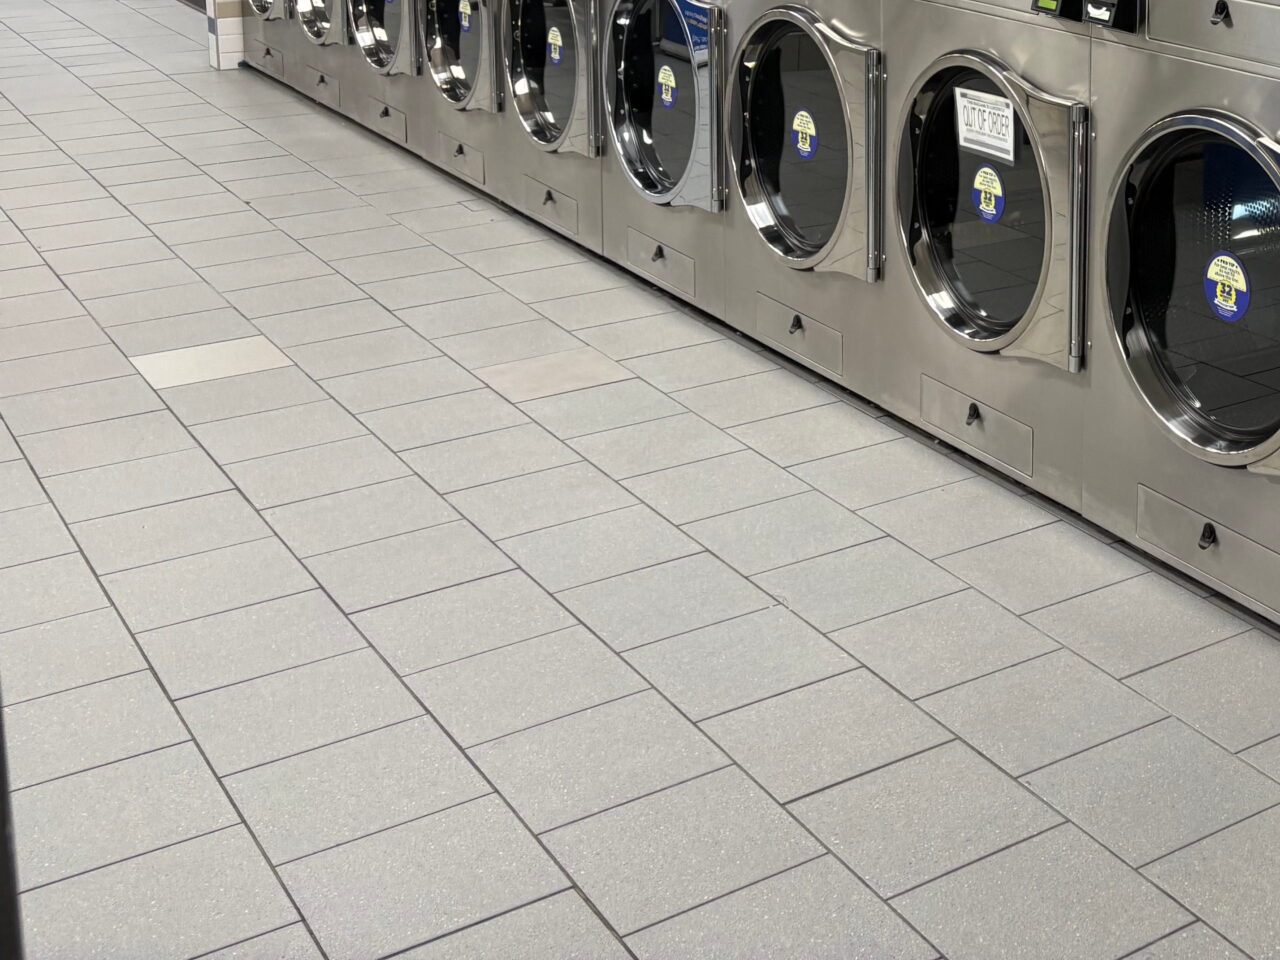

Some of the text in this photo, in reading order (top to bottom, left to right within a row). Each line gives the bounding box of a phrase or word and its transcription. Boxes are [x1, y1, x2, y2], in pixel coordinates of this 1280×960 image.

[963, 105, 976, 128] OUT
[978, 108, 986, 131] OF
[988, 111, 1009, 138] ORDER
[1221, 283, 1232, 296] 32
